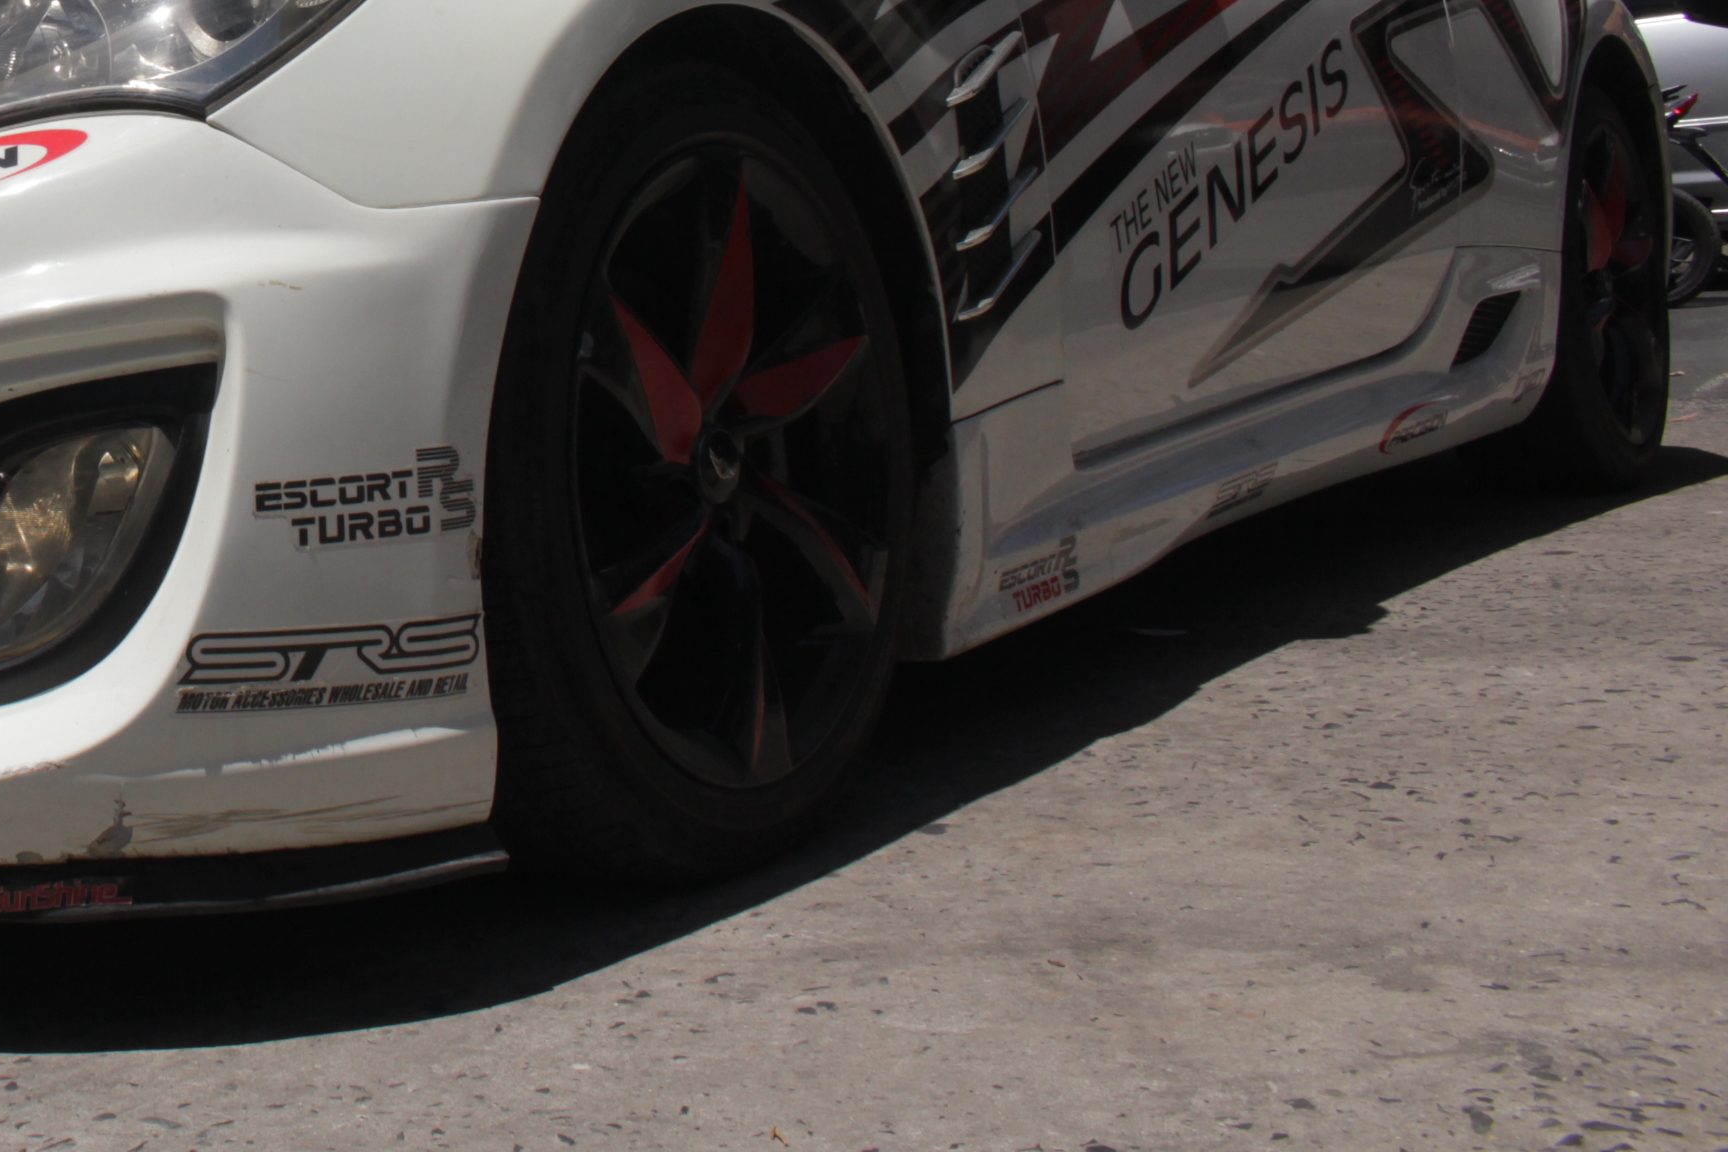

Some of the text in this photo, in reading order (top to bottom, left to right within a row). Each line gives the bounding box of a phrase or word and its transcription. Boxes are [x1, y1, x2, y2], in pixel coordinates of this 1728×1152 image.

[1109, 140, 1198, 256] THE NEW
[1119, 37, 1351, 331] GENESIS
[254, 469, 413, 513] ESCORT
[290, 505, 431, 547] TURBO
[1012, 575, 1062, 613] TURBO
[175, 672, 469, 712] MOTOR ACCESSORIES WHOLESALE AND RETAIL
